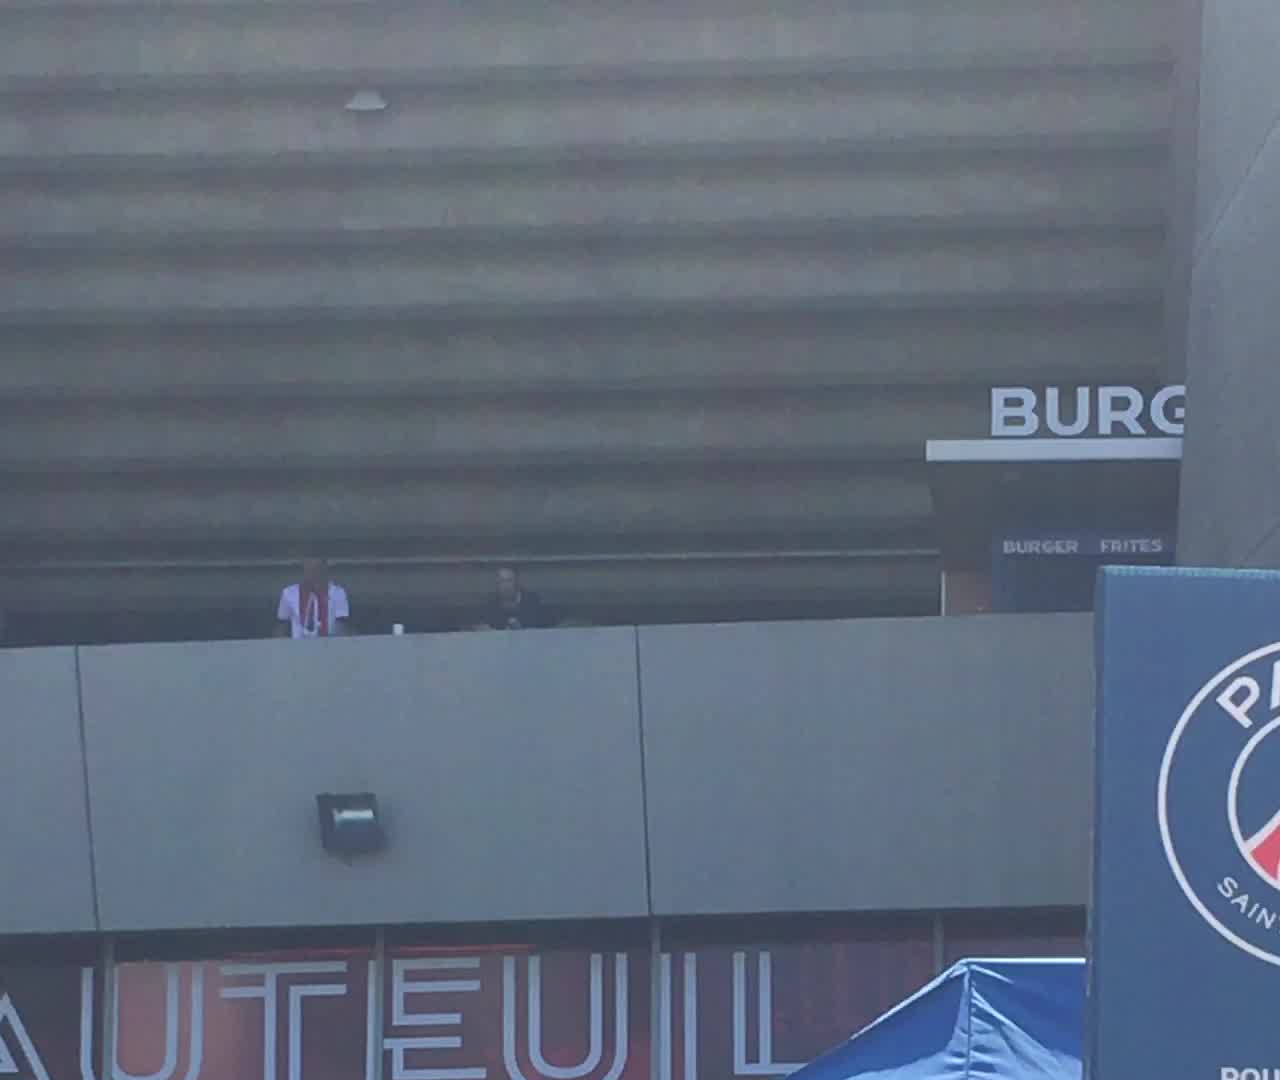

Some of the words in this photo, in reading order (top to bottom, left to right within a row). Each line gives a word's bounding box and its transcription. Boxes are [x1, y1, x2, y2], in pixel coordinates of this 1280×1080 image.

[991, 385, 1185, 436] BURG
[1003, 539, 1079, 554] BURGER
[1101, 538, 1163, 553] FRITES
